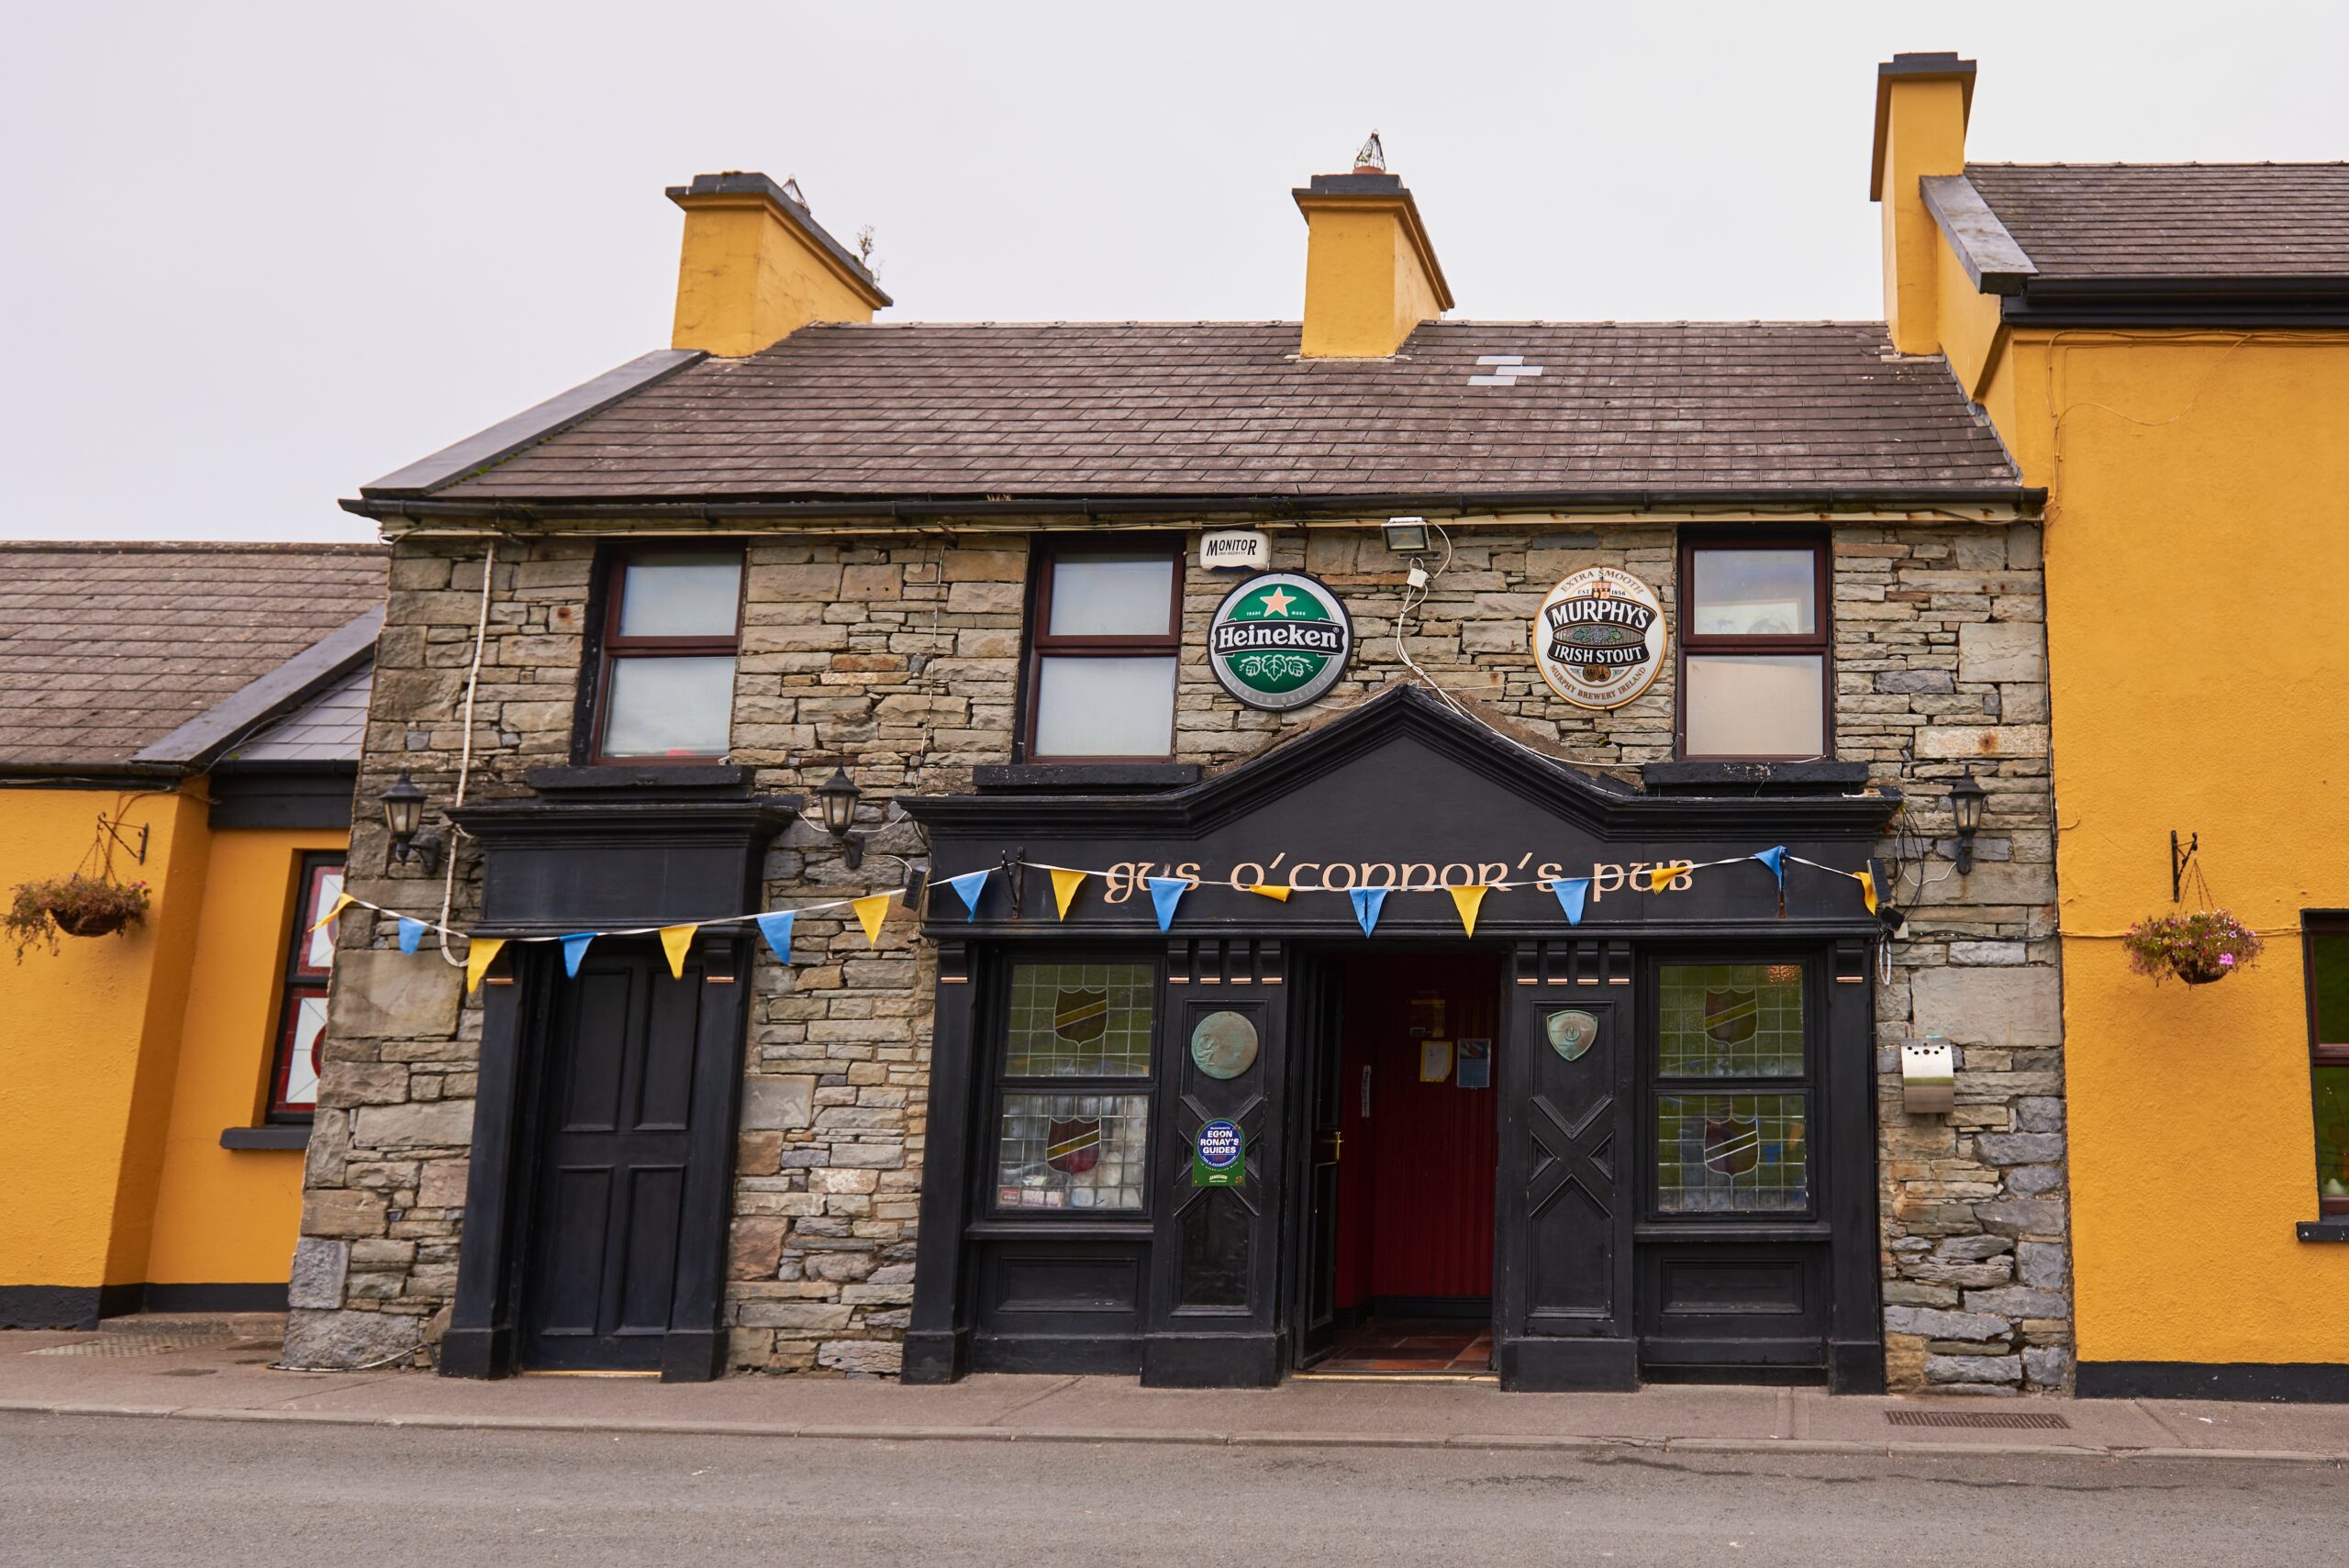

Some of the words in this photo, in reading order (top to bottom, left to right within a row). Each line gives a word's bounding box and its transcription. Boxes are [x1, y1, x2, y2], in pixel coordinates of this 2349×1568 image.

[1206, 539, 1258, 556] MONITOR
[1560, 569, 1595, 593] EXTRA
[1598, 569, 1645, 595] SMOOTH
[1551, 600, 1649, 628] MURPHY'S
[1219, 624, 1338, 649] Heineken
[1553, 644, 1594, 662] IRISH
[1596, 646, 1642, 663] STOUT
[1549, 664, 1576, 694] MURPHY
[1576, 689, 1617, 700] BREWERY
[1618, 666, 1646, 695] IRELAND
[1203, 1146, 1236, 1154] GUIDES
